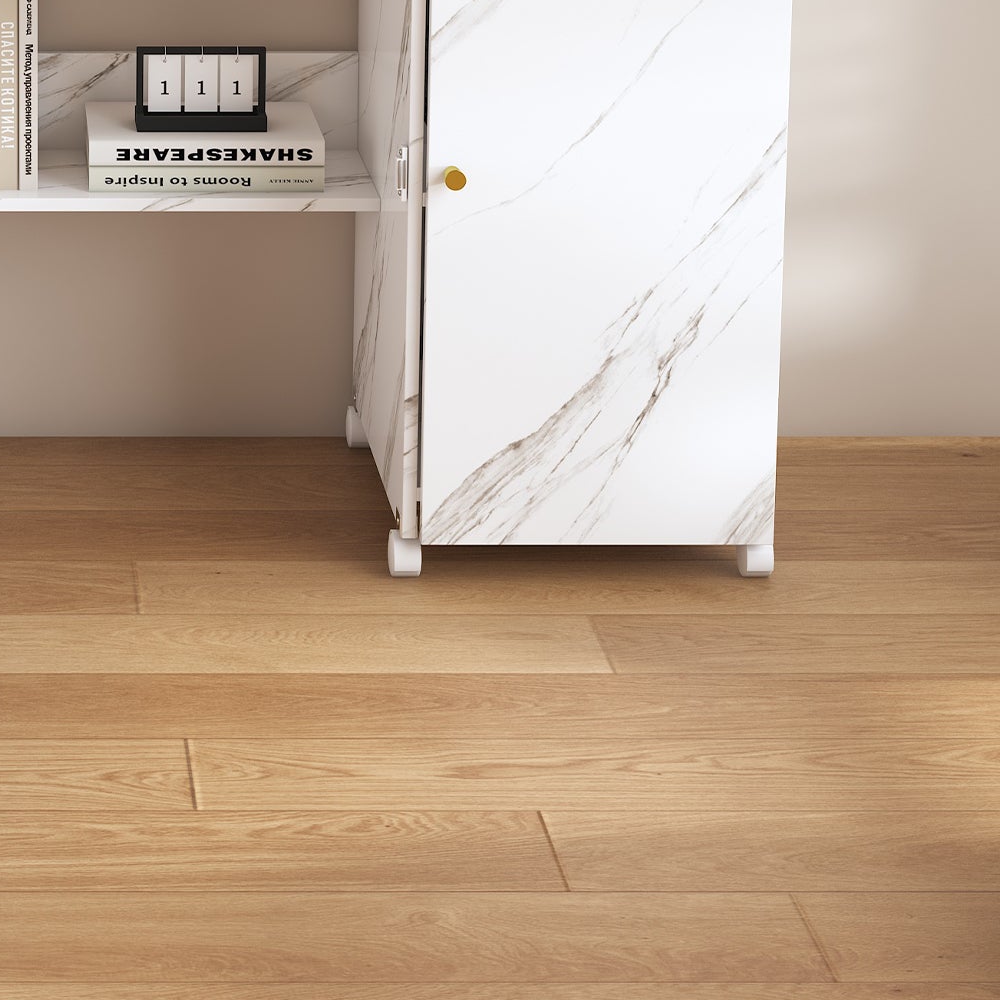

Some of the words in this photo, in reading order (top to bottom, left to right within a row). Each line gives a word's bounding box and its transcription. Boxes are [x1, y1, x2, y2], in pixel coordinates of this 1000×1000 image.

[0, 21, 14, 84] СПАСИТЕ
[25, 44, 34, 72] Метод
[160, 80, 170, 95] 1
[197, 80, 206, 95] 1
[233, 80, 242, 95] 1
[23, 72, 32, 127] управления
[1, 87, 15, 149] КОТИКА!
[23, 128, 32, 175] проектами
[116, 148, 314, 162] SHAKESPEARE
[104, 175, 164, 187] Inspire
[169, 176, 188, 186] to
[193, 176, 252, 187] Rooms
